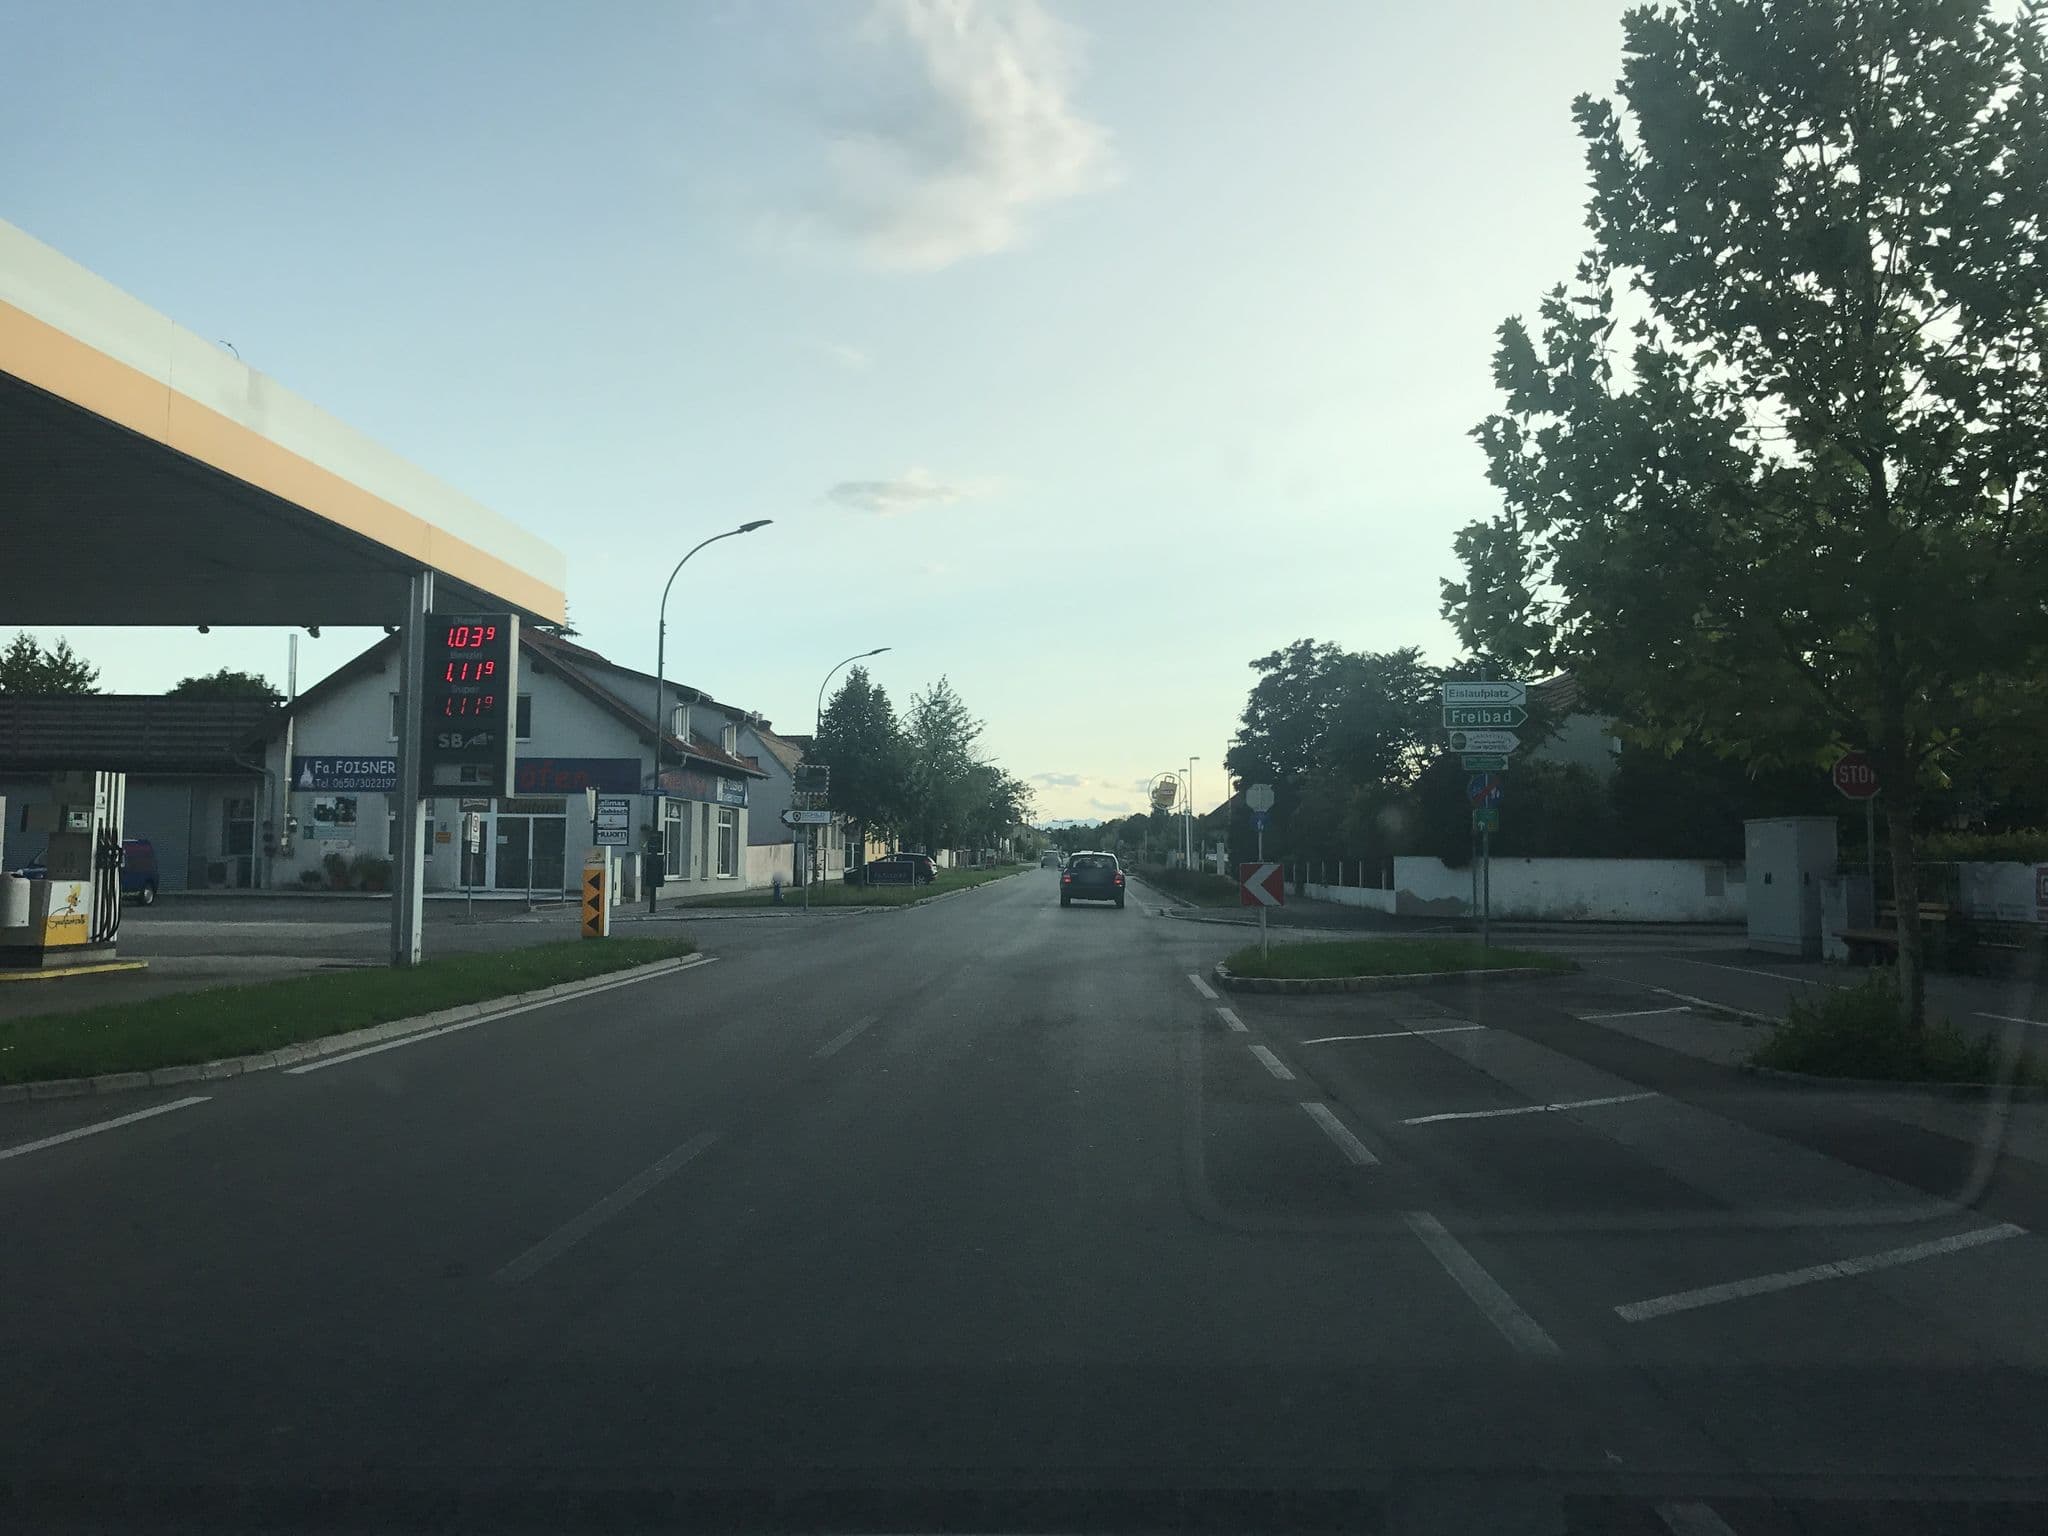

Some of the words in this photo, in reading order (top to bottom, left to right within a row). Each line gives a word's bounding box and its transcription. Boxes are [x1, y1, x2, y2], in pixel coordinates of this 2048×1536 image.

[1448, 688, 1509, 699] Eislaufplatz
[1452, 709, 1512, 723] Freibad
[438, 733, 463, 749] SB
